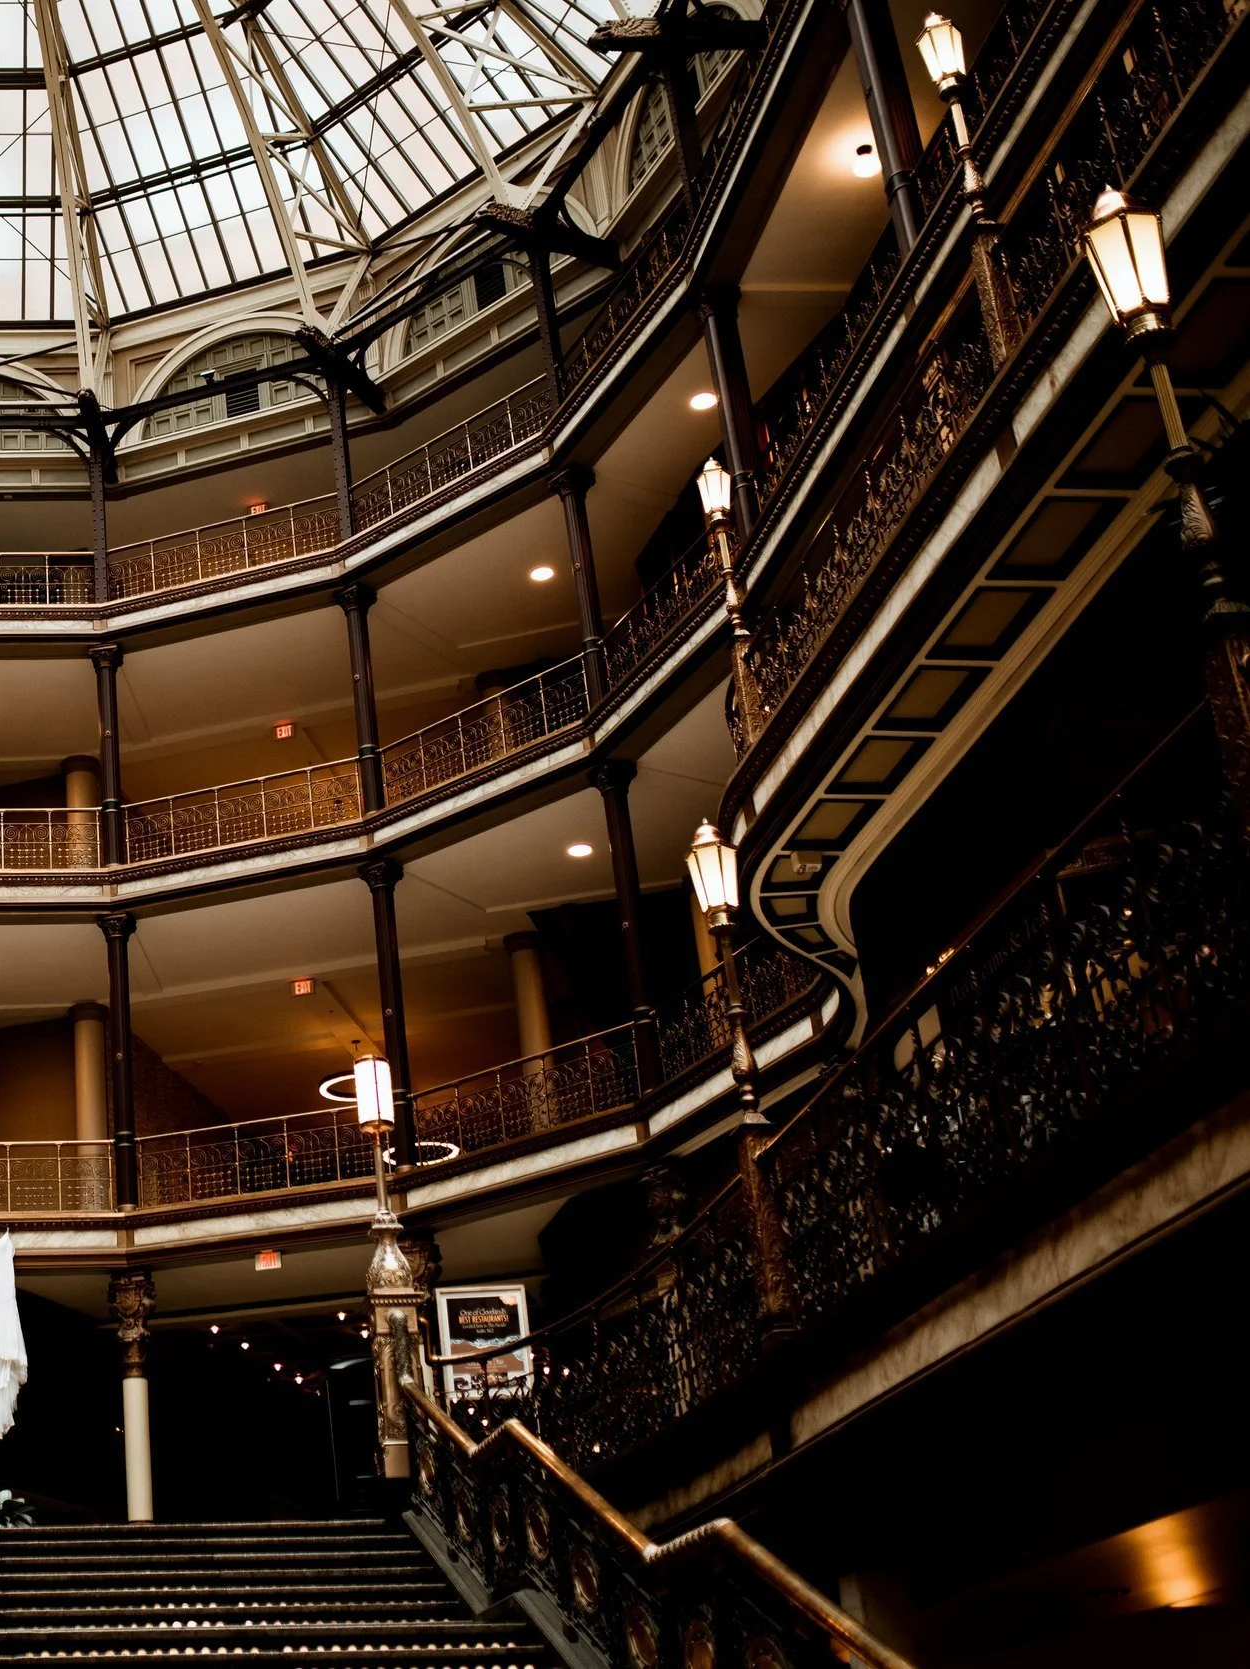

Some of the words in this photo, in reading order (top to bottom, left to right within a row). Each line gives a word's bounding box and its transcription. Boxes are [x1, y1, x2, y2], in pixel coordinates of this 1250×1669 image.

[251, 504, 266, 515] EXIT
[276, 725, 293, 739] EXIT
[294, 980, 311, 995] EXIT
[458, 1315, 471, 1324] BEST
[472, 1314, 509, 1323] RESTAURANTS!
